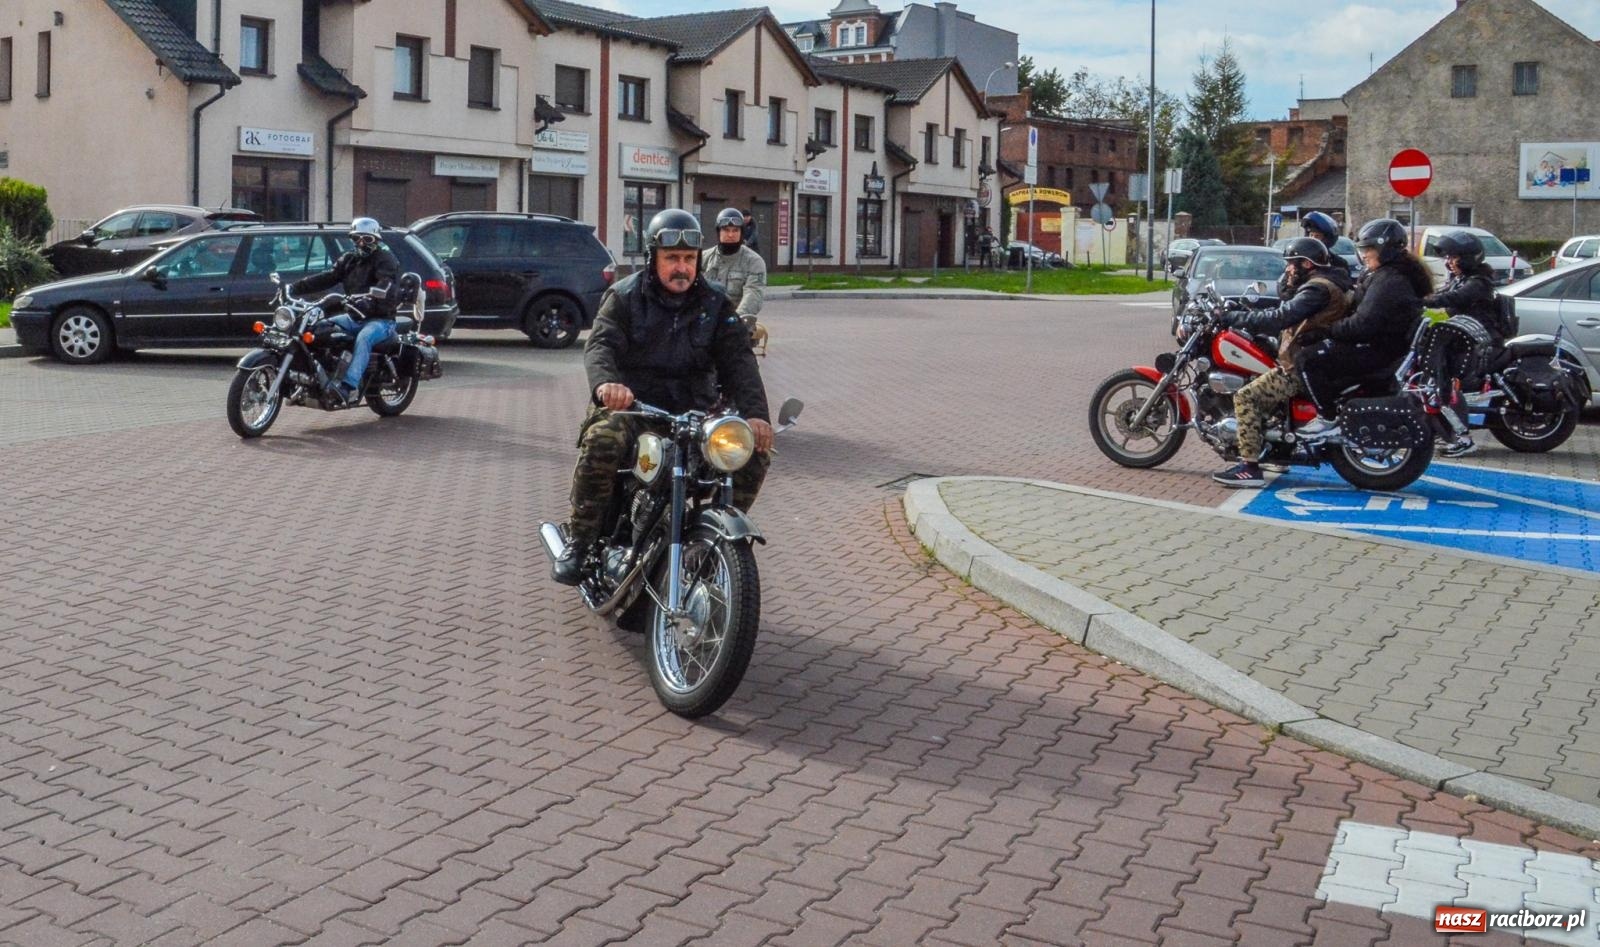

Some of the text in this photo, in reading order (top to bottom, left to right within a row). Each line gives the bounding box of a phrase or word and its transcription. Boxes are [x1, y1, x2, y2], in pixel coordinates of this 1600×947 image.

[267, 133, 311, 143] FOTOGRAF
[633, 148, 672, 167] dentica
[1011, 189, 1037, 197] NAPRAA
